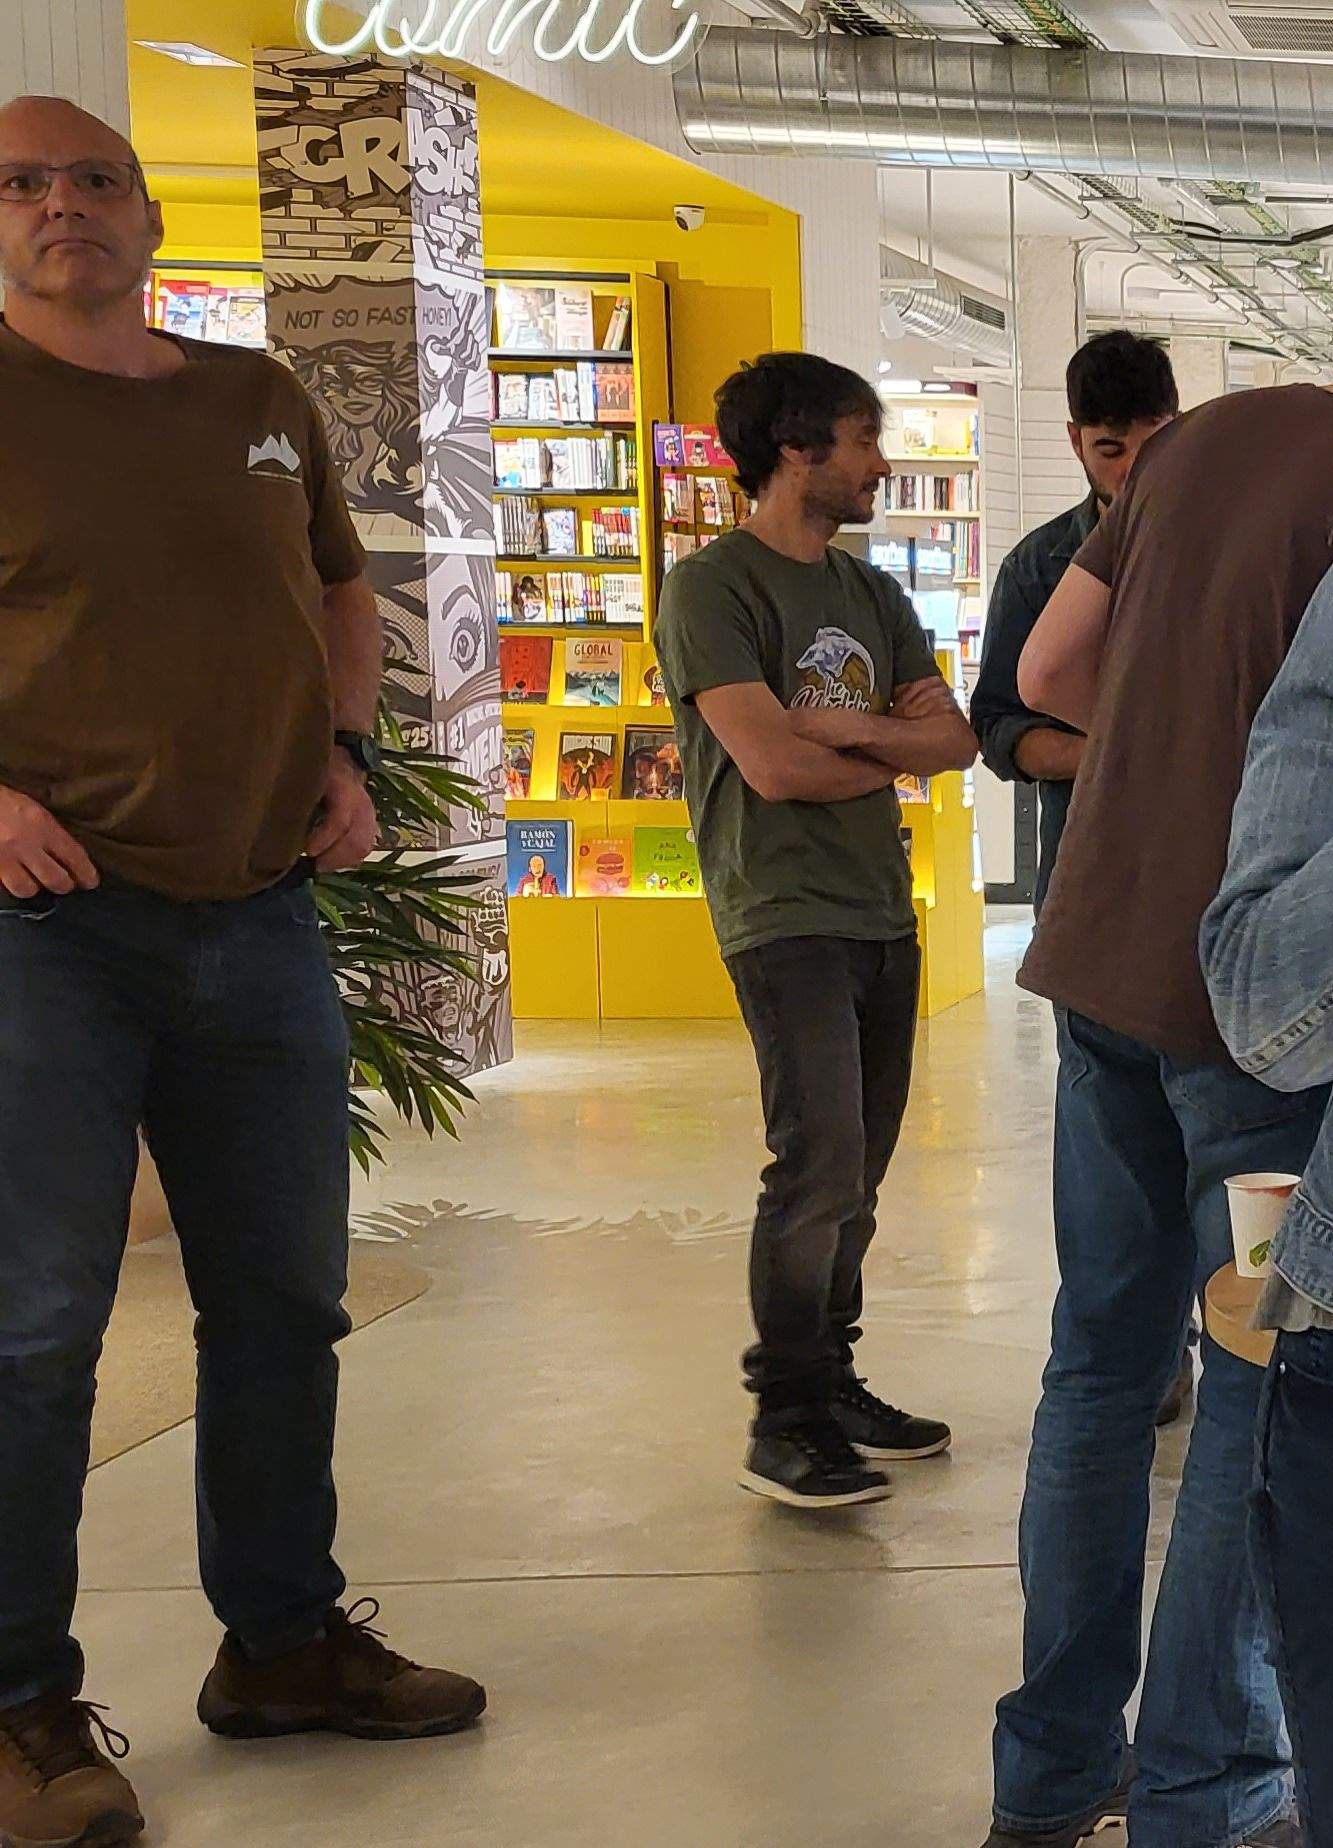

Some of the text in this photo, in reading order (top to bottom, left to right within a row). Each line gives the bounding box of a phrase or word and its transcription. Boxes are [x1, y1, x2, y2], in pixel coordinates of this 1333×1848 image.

[285, 310, 324, 330] NOT
[332, 308, 359, 328] SO
[366, 305, 417, 326] FAST
